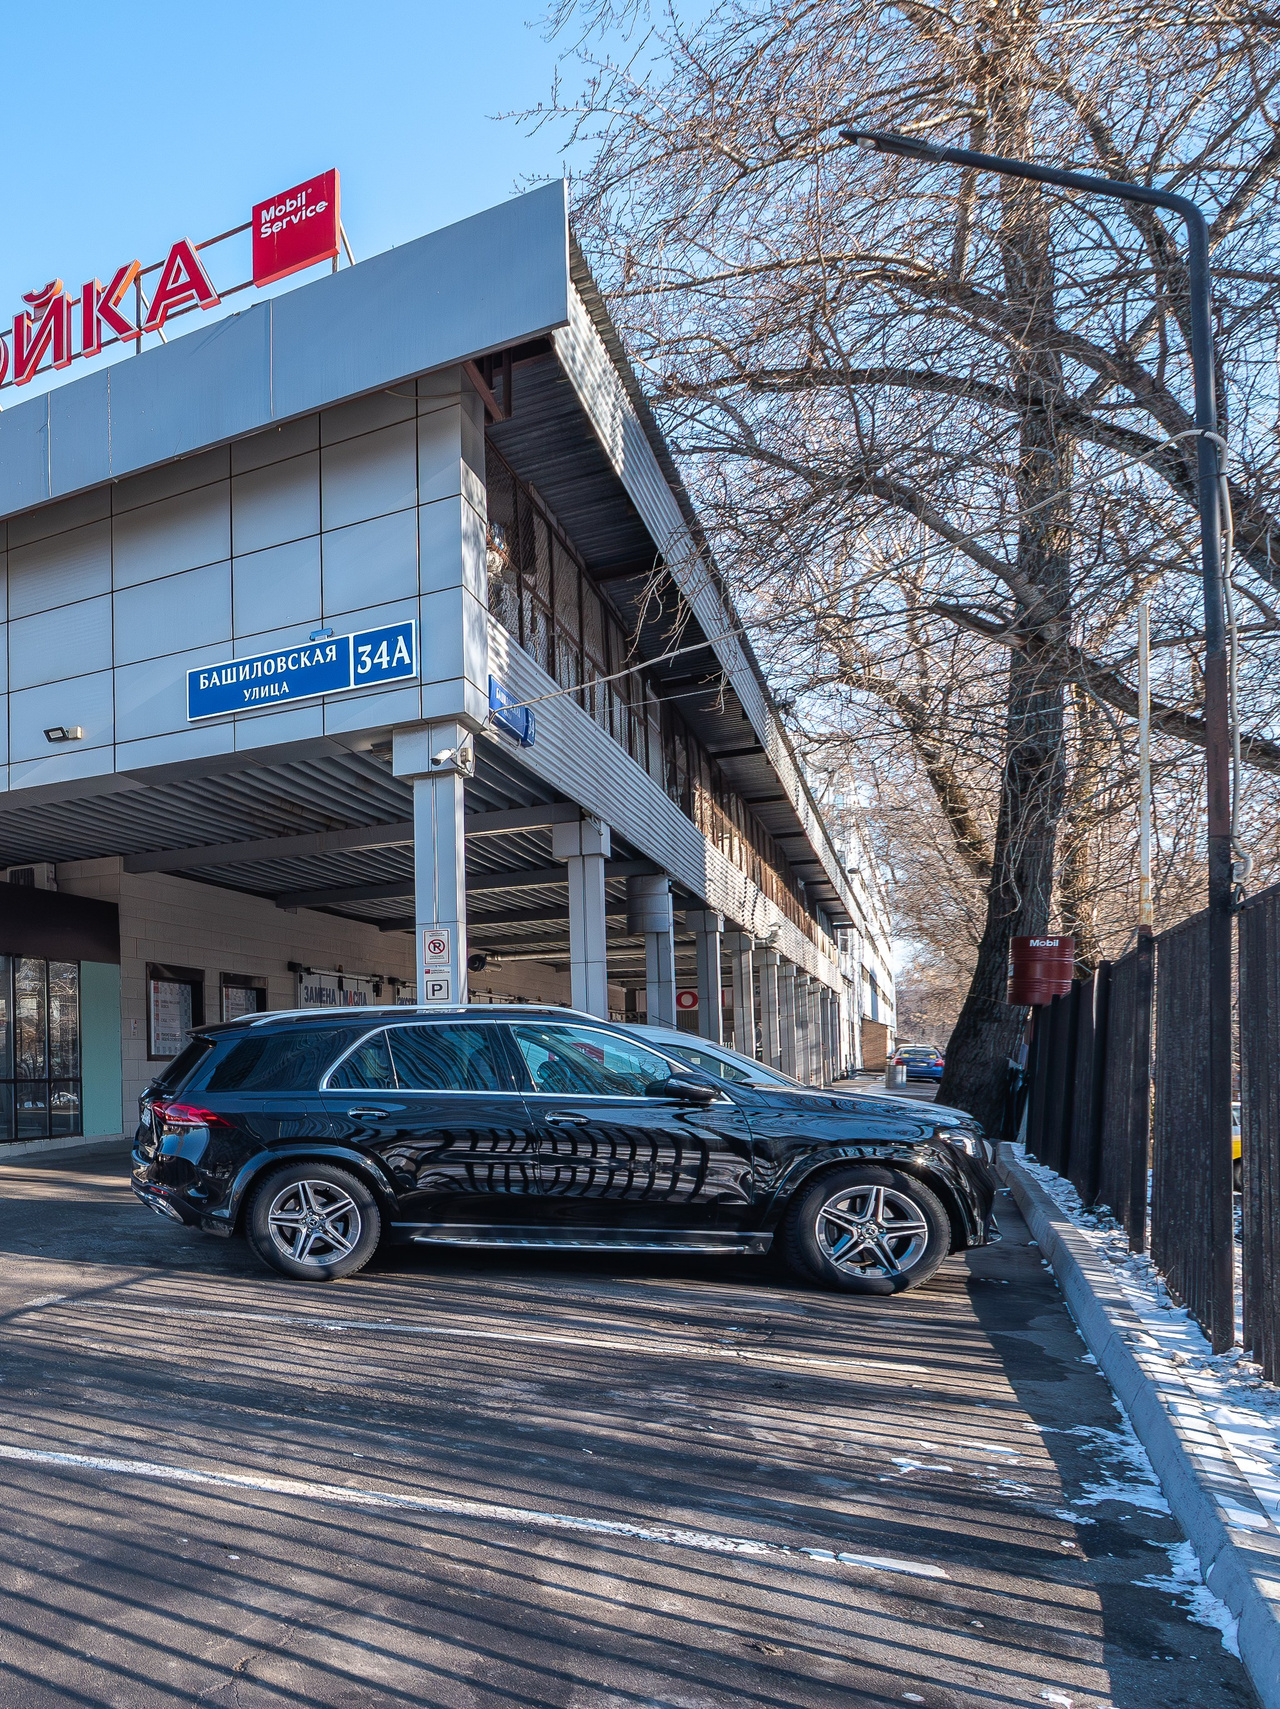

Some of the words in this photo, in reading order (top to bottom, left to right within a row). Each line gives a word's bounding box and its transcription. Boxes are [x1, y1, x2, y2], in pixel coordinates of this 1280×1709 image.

[260, 200, 328, 238] Service
[261, 191, 306, 224] Mobil
[199, 644, 337, 689] БАШИЛОВСКАЯ
[356, 635, 412, 674] 34А
[243, 681, 290, 701] УЛИЦА
[1029, 939, 1059, 947] Mobil
[304, 985, 337, 1005] ЗАМЕНА
[342, 989, 368, 1006] МАСЛА
